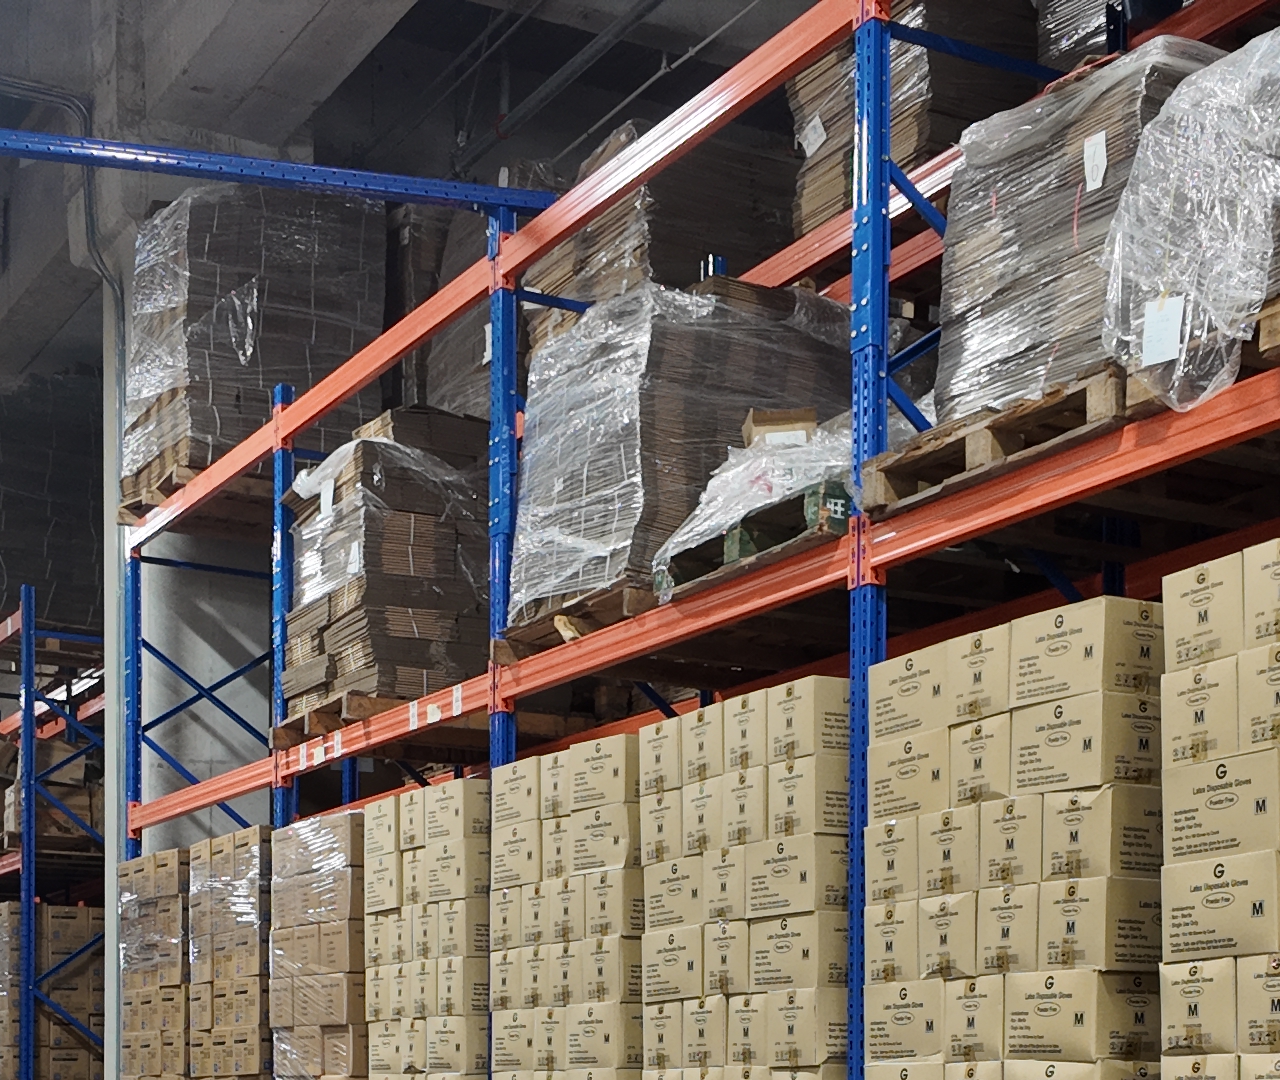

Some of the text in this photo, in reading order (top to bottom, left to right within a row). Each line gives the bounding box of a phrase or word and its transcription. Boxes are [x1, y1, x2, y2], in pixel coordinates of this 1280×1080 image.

[1054, 614, 1064, 629] G
[1084, 646, 1093, 659] M
[1045, 976, 1055, 990] G
[1074, 1013, 1084, 1026] M
